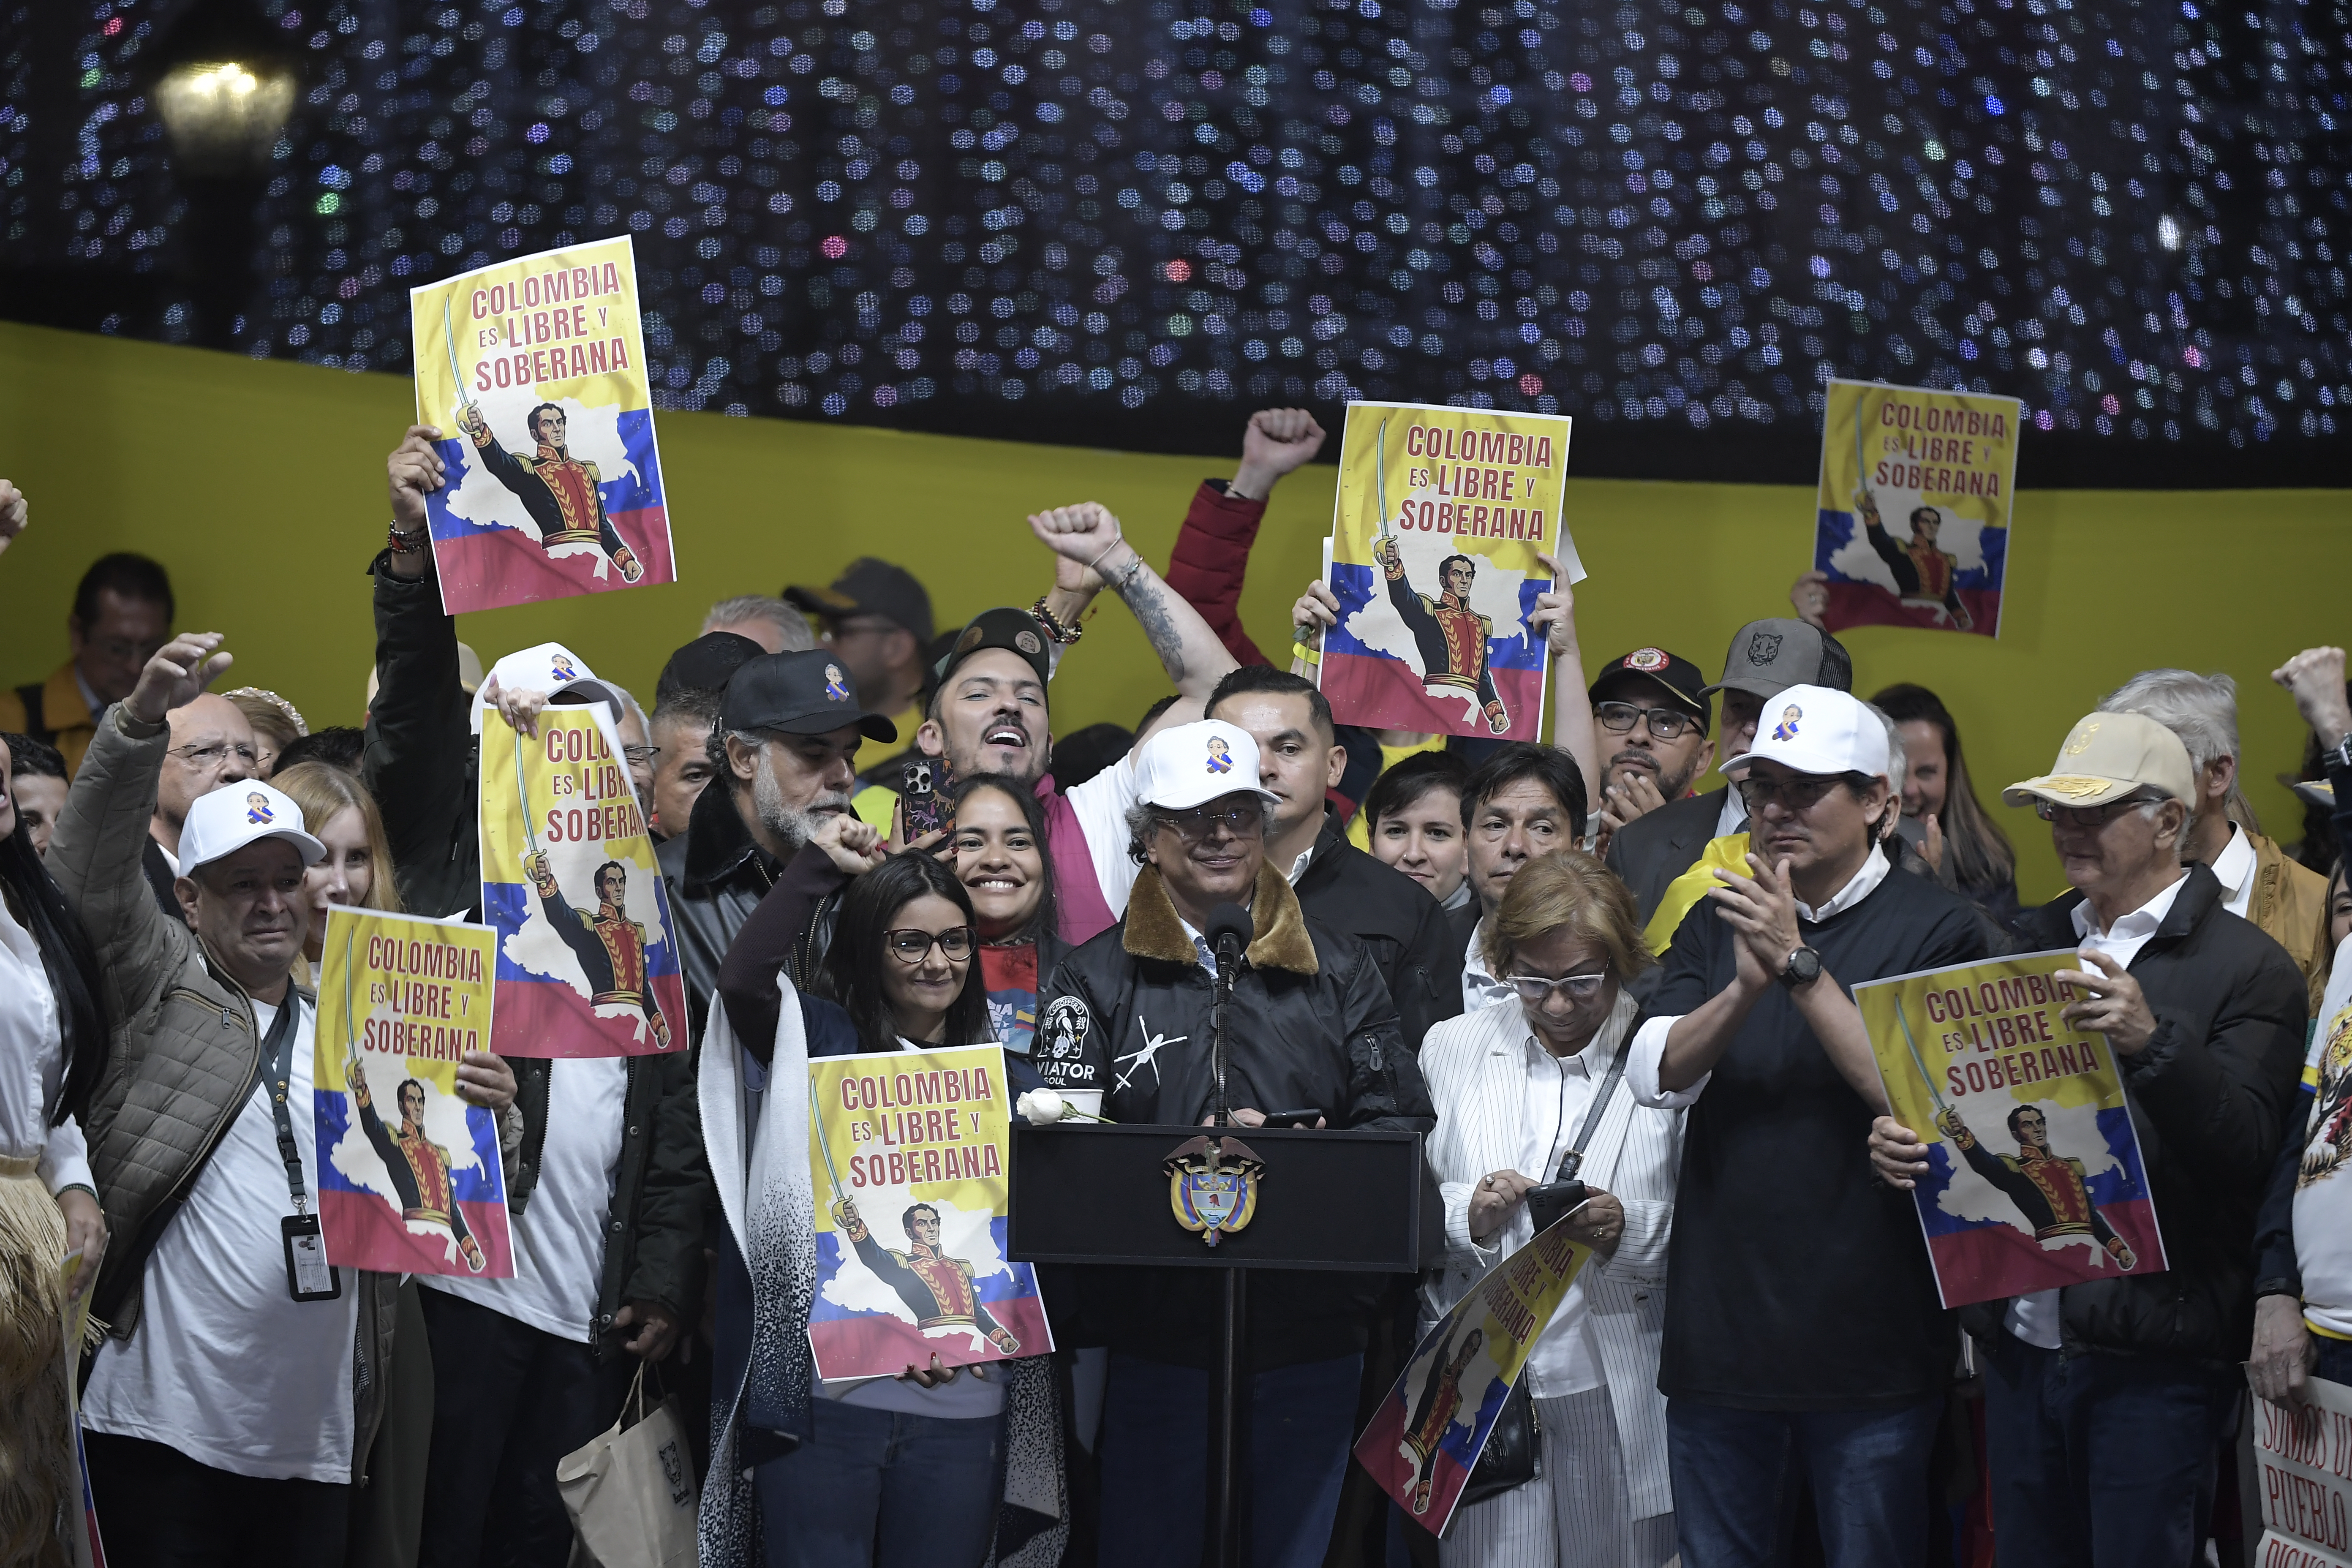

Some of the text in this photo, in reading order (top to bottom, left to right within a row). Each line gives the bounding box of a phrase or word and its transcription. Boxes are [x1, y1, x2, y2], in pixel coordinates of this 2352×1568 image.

[472, 262, 619, 320] COLOMBIA
[479, 304, 608, 348] ES LIBRE Y
[475, 338, 629, 392] SOBERANA
[1881, 403, 2004, 439] COLOMBIA
[1407, 425, 1552, 468] COLOMBIA
[1884, 436, 1991, 466] ES LIBRE Y
[1408, 464, 1536, 503] ES LIBRE Y
[1876, 461, 2000, 498] SOBERANA
[1399, 499, 1544, 542] SOBERANA
[546, 727, 615, 763] COLO
[553, 764, 631, 801] ES LIBR
[368, 935, 482, 984] COLOMBIA
[370, 979, 470, 1020] ES LIBRE Y
[1052, 999, 1081, 1013] CHOPPERS
[1925, 973, 2076, 1023] COLOMBIA
[363, 1018, 478, 1062] SOBERANA
[1942, 1031, 1964, 1053] ES
[1970, 1010, 2054, 1053] LIBRE
[840, 1066, 992, 1111] COLOMBIA
[1946, 1041, 2101, 1096] SOBERANA
[851, 1108, 980, 1147] ES LIBRE Y
[849, 1143, 1002, 1188] SOBERANA
[1535, 1281, 1547, 1300] Y
[2262, 1399, 2352, 1481] SOMOS U
[2265, 1464, 2348, 1552] PUEBLO
